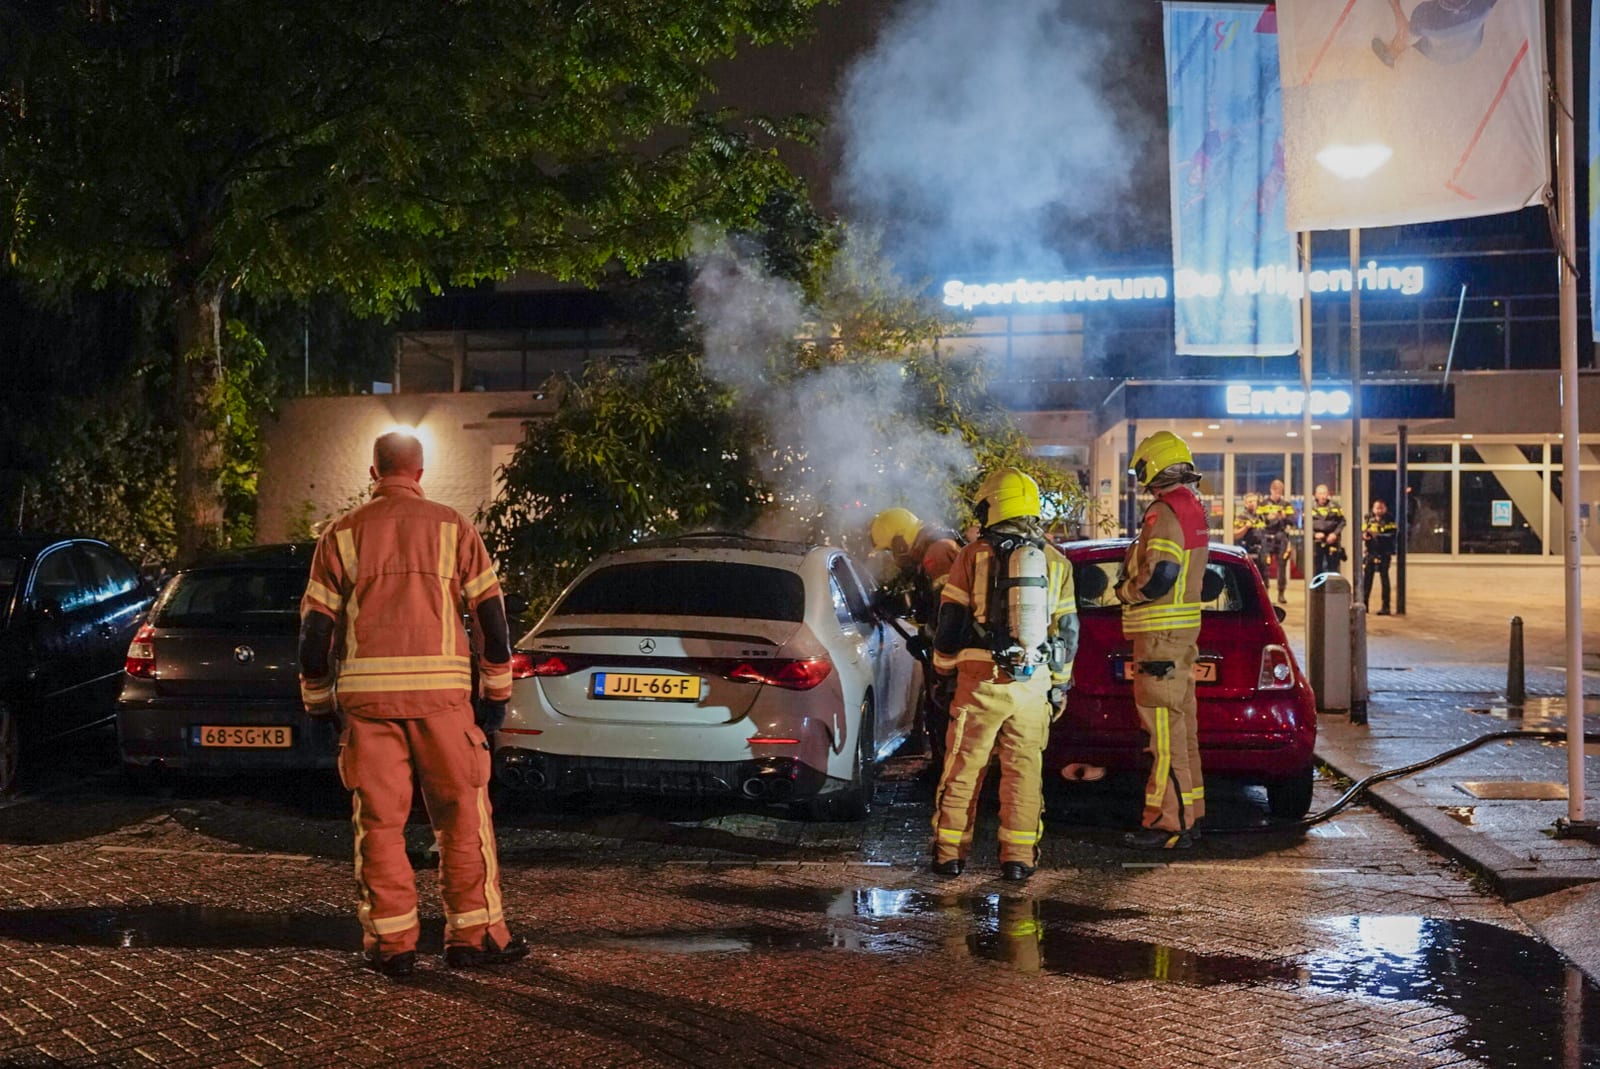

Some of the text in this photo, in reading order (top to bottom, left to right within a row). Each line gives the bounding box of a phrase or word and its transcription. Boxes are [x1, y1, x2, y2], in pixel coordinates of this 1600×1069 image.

[943, 274, 1167, 310] Sportcentrum
[1226, 385, 1351, 415] Entree
[612, 677, 690, 695] JJL-66-F
[206, 729, 284, 744] 68-SG-KB
